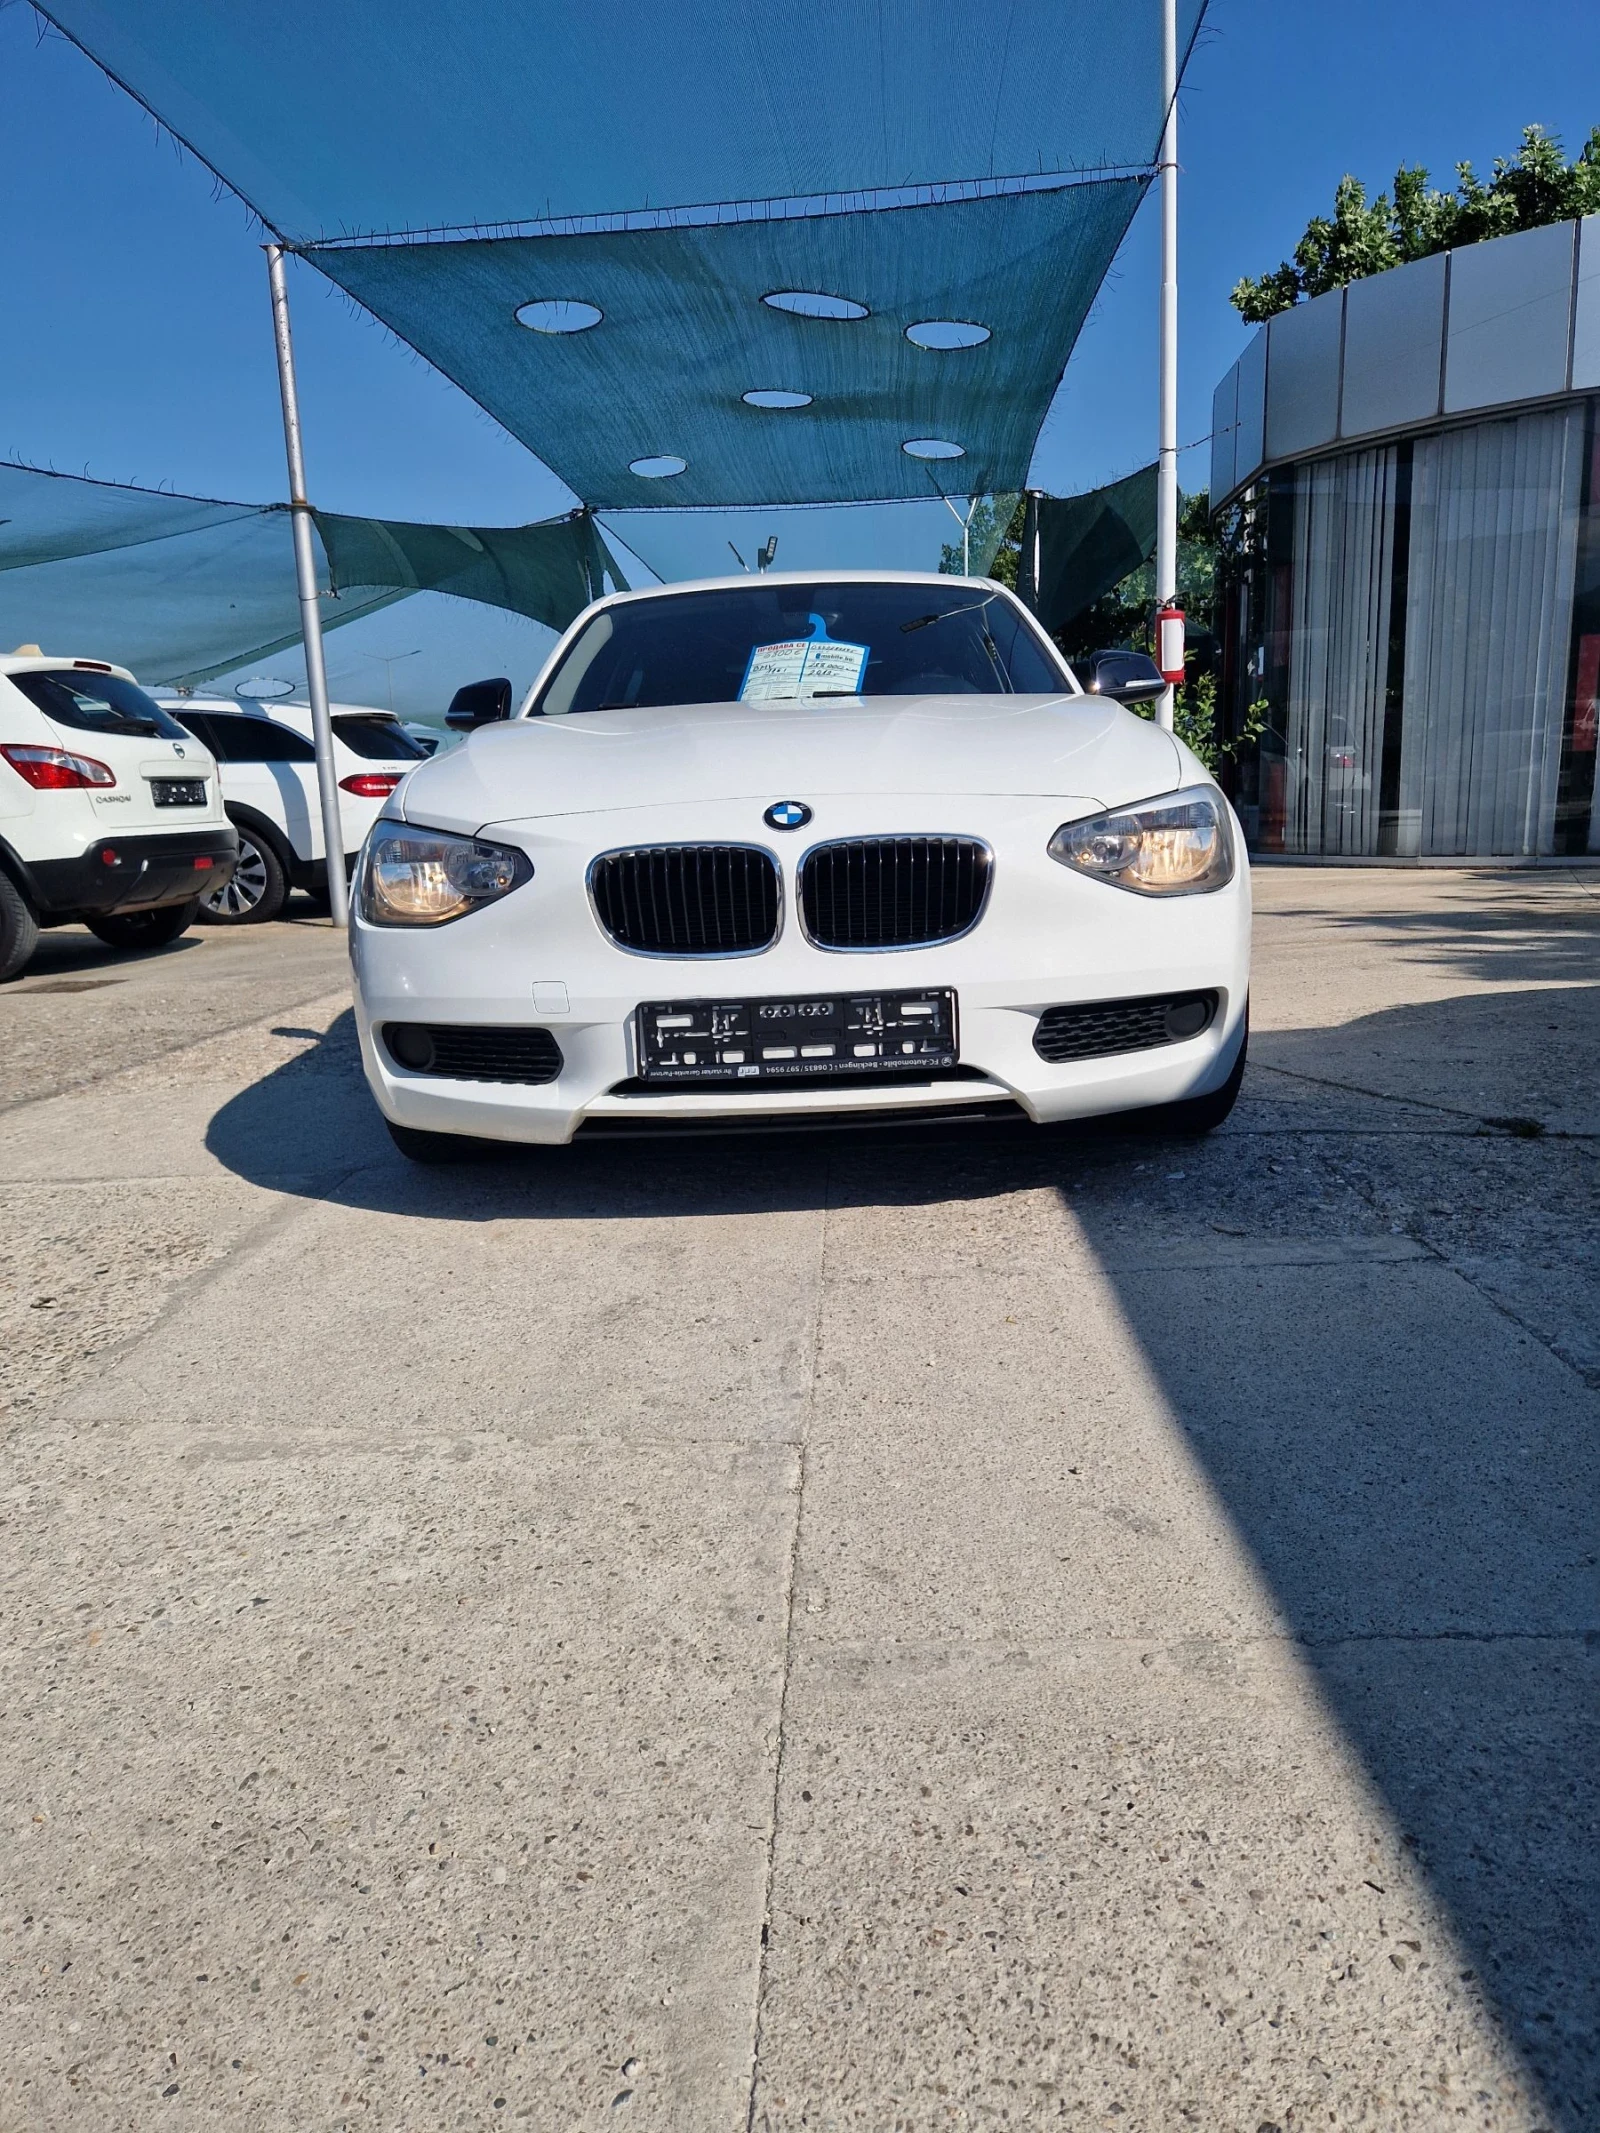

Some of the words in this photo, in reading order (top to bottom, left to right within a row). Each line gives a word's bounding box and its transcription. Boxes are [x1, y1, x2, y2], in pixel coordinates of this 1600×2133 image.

[757, 643, 794, 653] ПРОДАВА
[839, 1061, 878, 1070] Beckingen
[883, 1058, 939, 1068] FC-Automobile
[650, 1069, 701, 1078] Garantie-Partner
[701, 1069, 722, 1077] starker
[723, 1068, 732, 1076] Ihr
[765, 1066, 785, 1074] 9594
